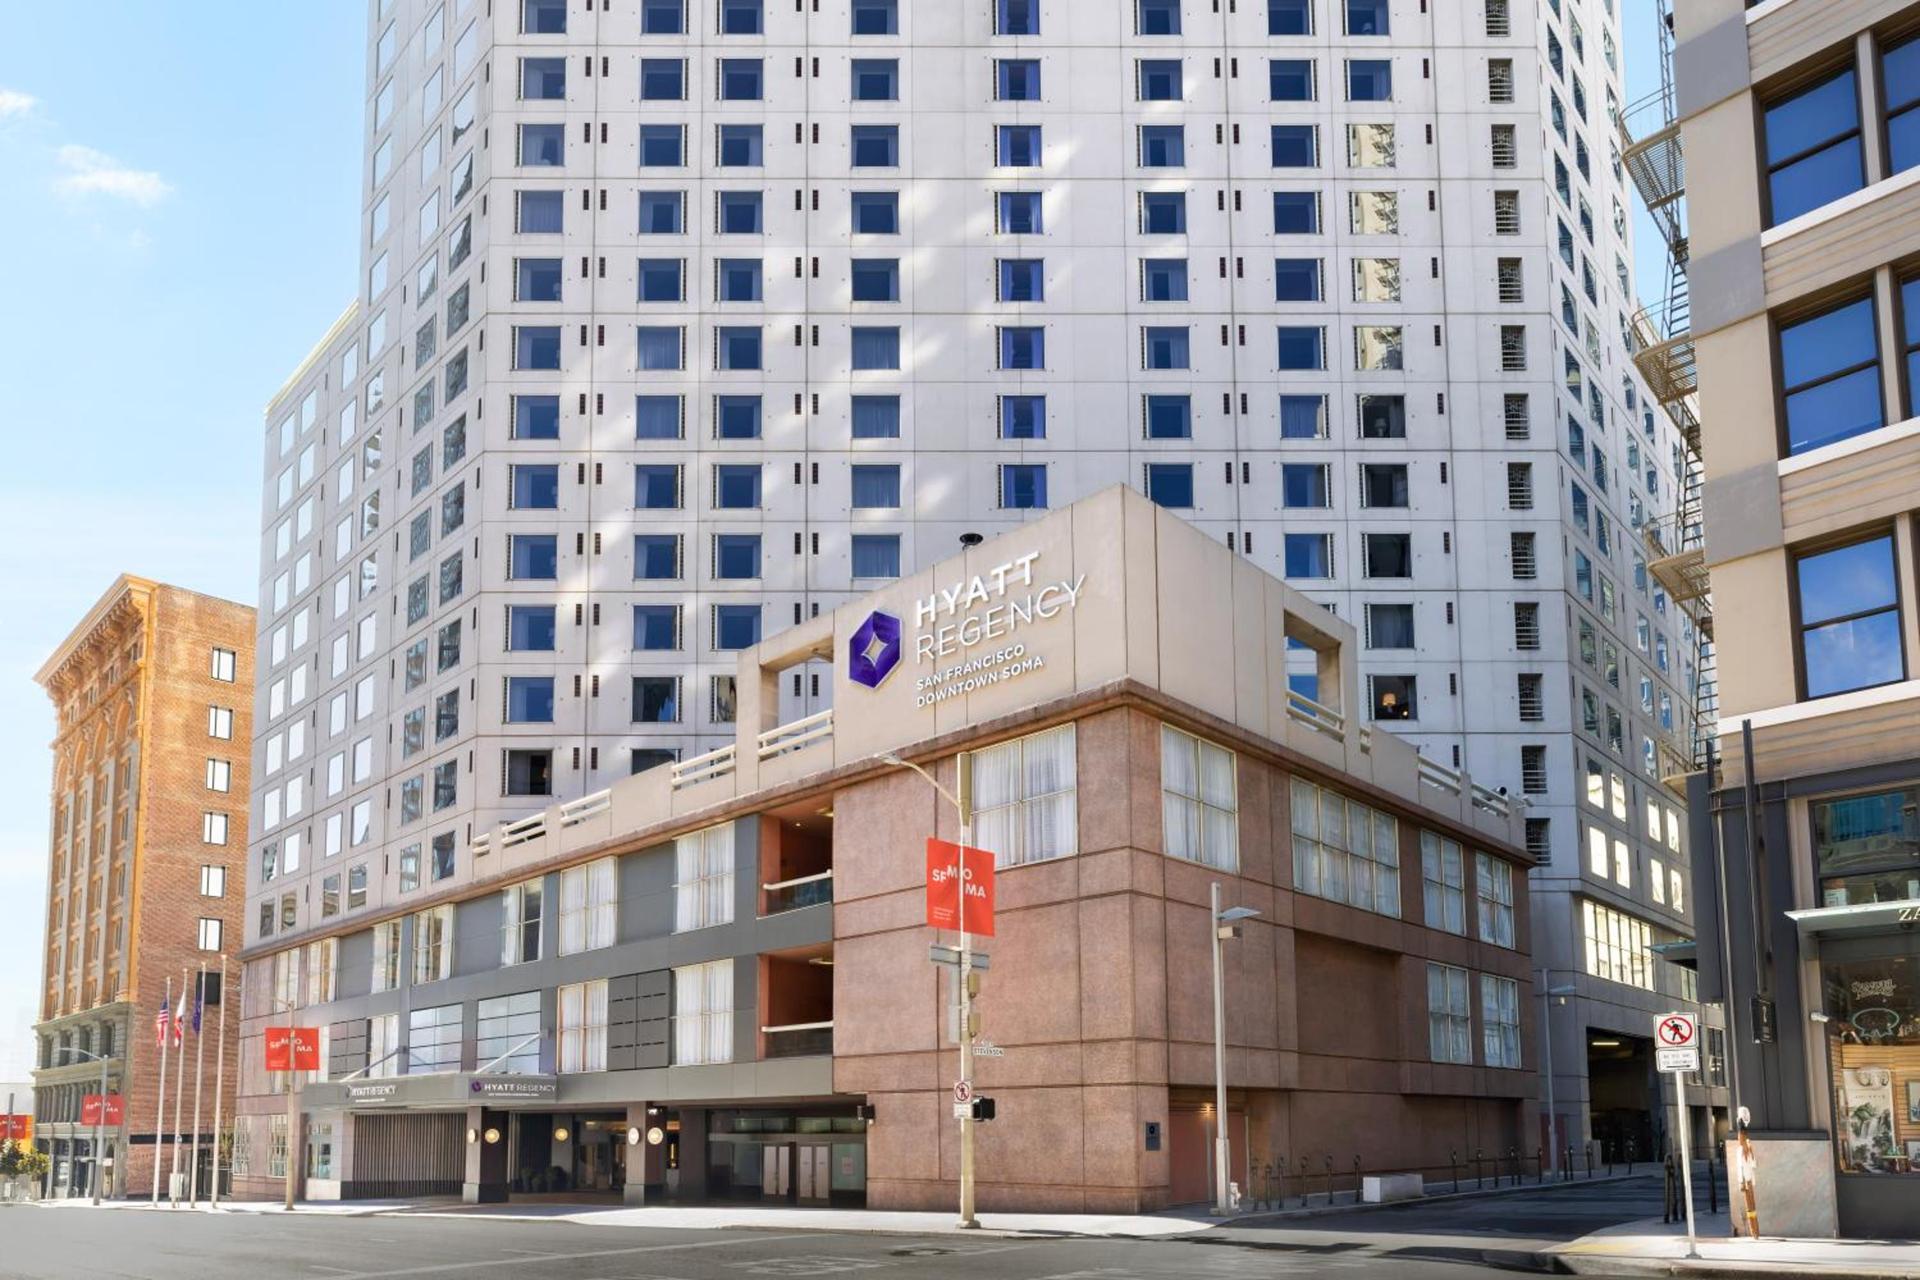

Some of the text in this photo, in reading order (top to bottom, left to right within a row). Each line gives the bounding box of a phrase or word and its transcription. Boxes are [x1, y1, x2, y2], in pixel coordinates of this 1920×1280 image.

[916, 550, 1041, 628] HYATT
[916, 573, 1087, 665] REGENCY
[916, 644, 1026, 692] SAN FRANCISCO
[916, 656, 1044, 708] DOWNTOWN SOMA
[484, 1083, 556, 1092] HYATT REGENCY
